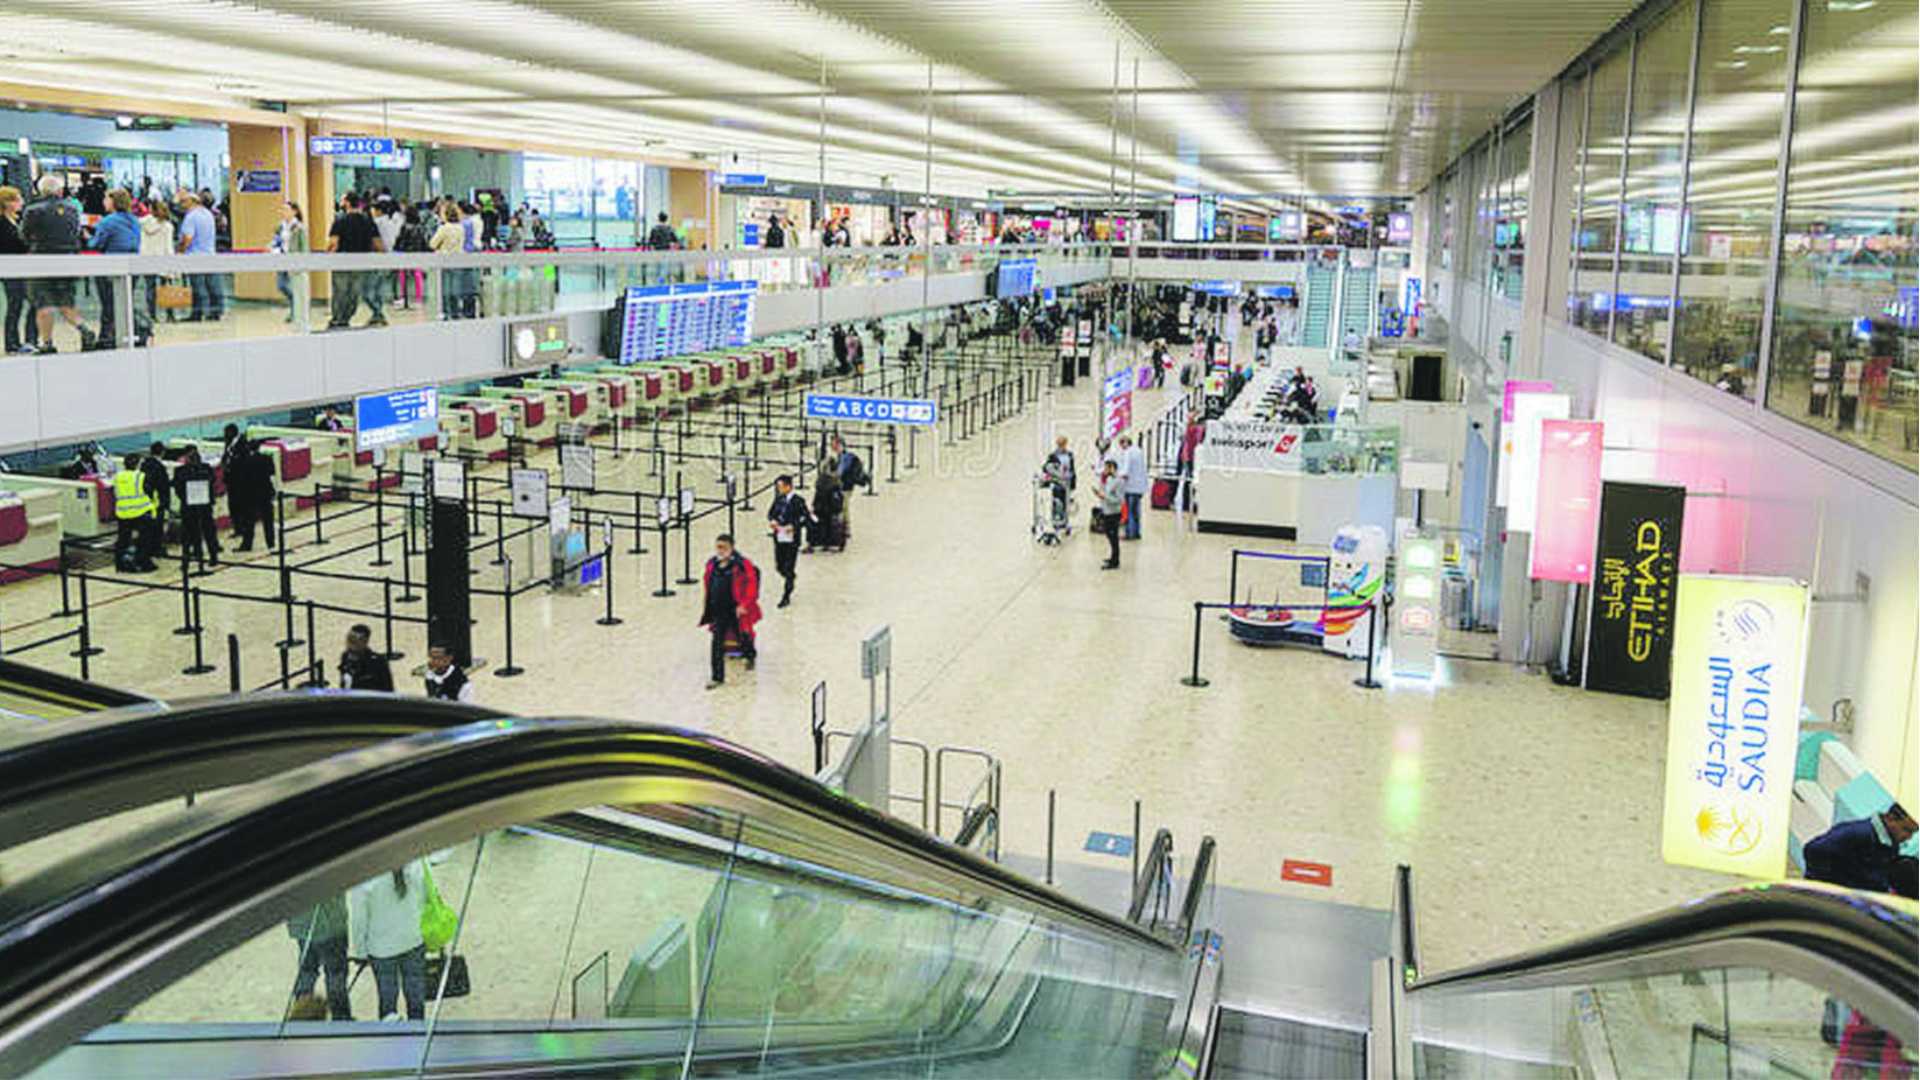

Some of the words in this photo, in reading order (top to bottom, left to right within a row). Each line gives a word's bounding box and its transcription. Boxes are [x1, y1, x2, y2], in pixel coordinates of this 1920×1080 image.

[1627, 520, 1661, 662] ETIHAD
[1697, 656, 1735, 788] السعودية
[1736, 663, 1772, 793] SAUDIA
